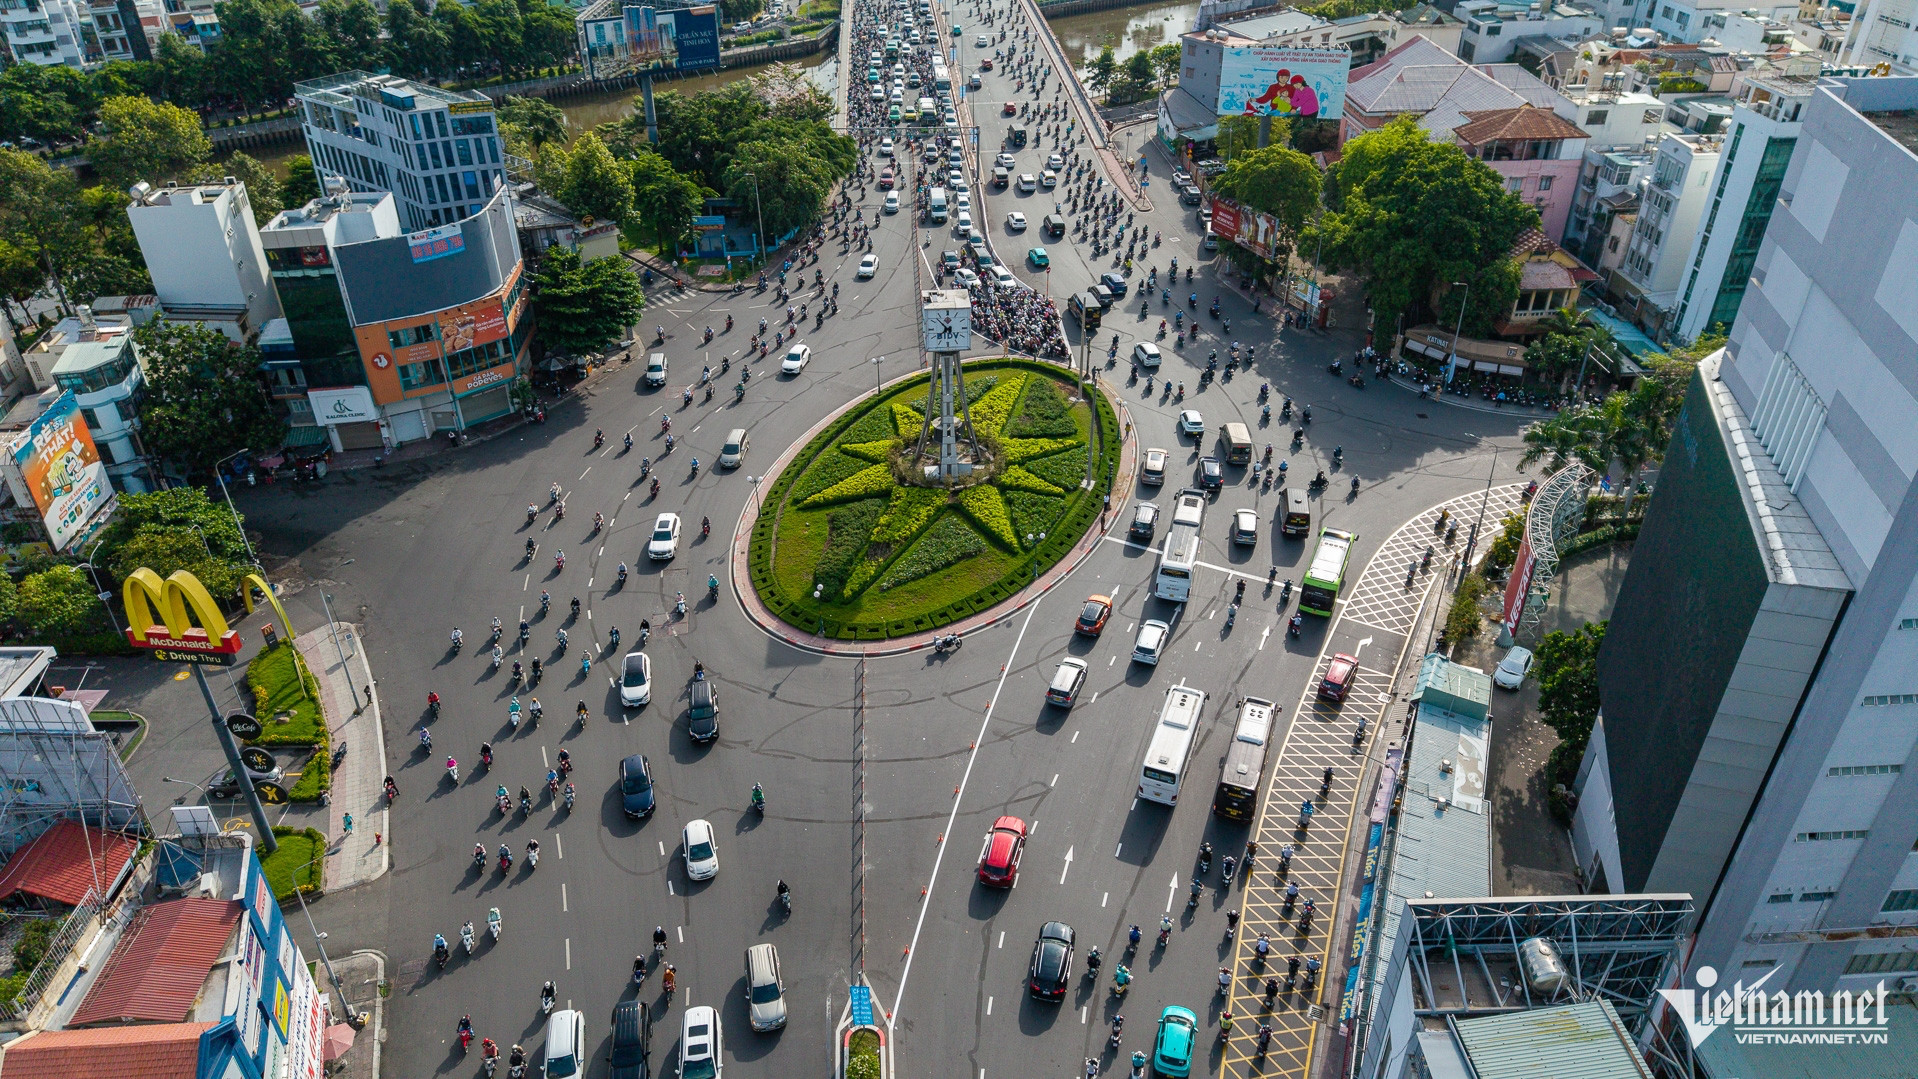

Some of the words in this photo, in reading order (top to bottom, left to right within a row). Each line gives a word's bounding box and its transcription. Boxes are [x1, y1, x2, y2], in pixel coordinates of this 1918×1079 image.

[40, 421, 75, 464] THẬT!
[150, 637, 214, 650] McDonald's
[169, 650, 198, 662] Drive
[200, 654, 221, 663] Thru
